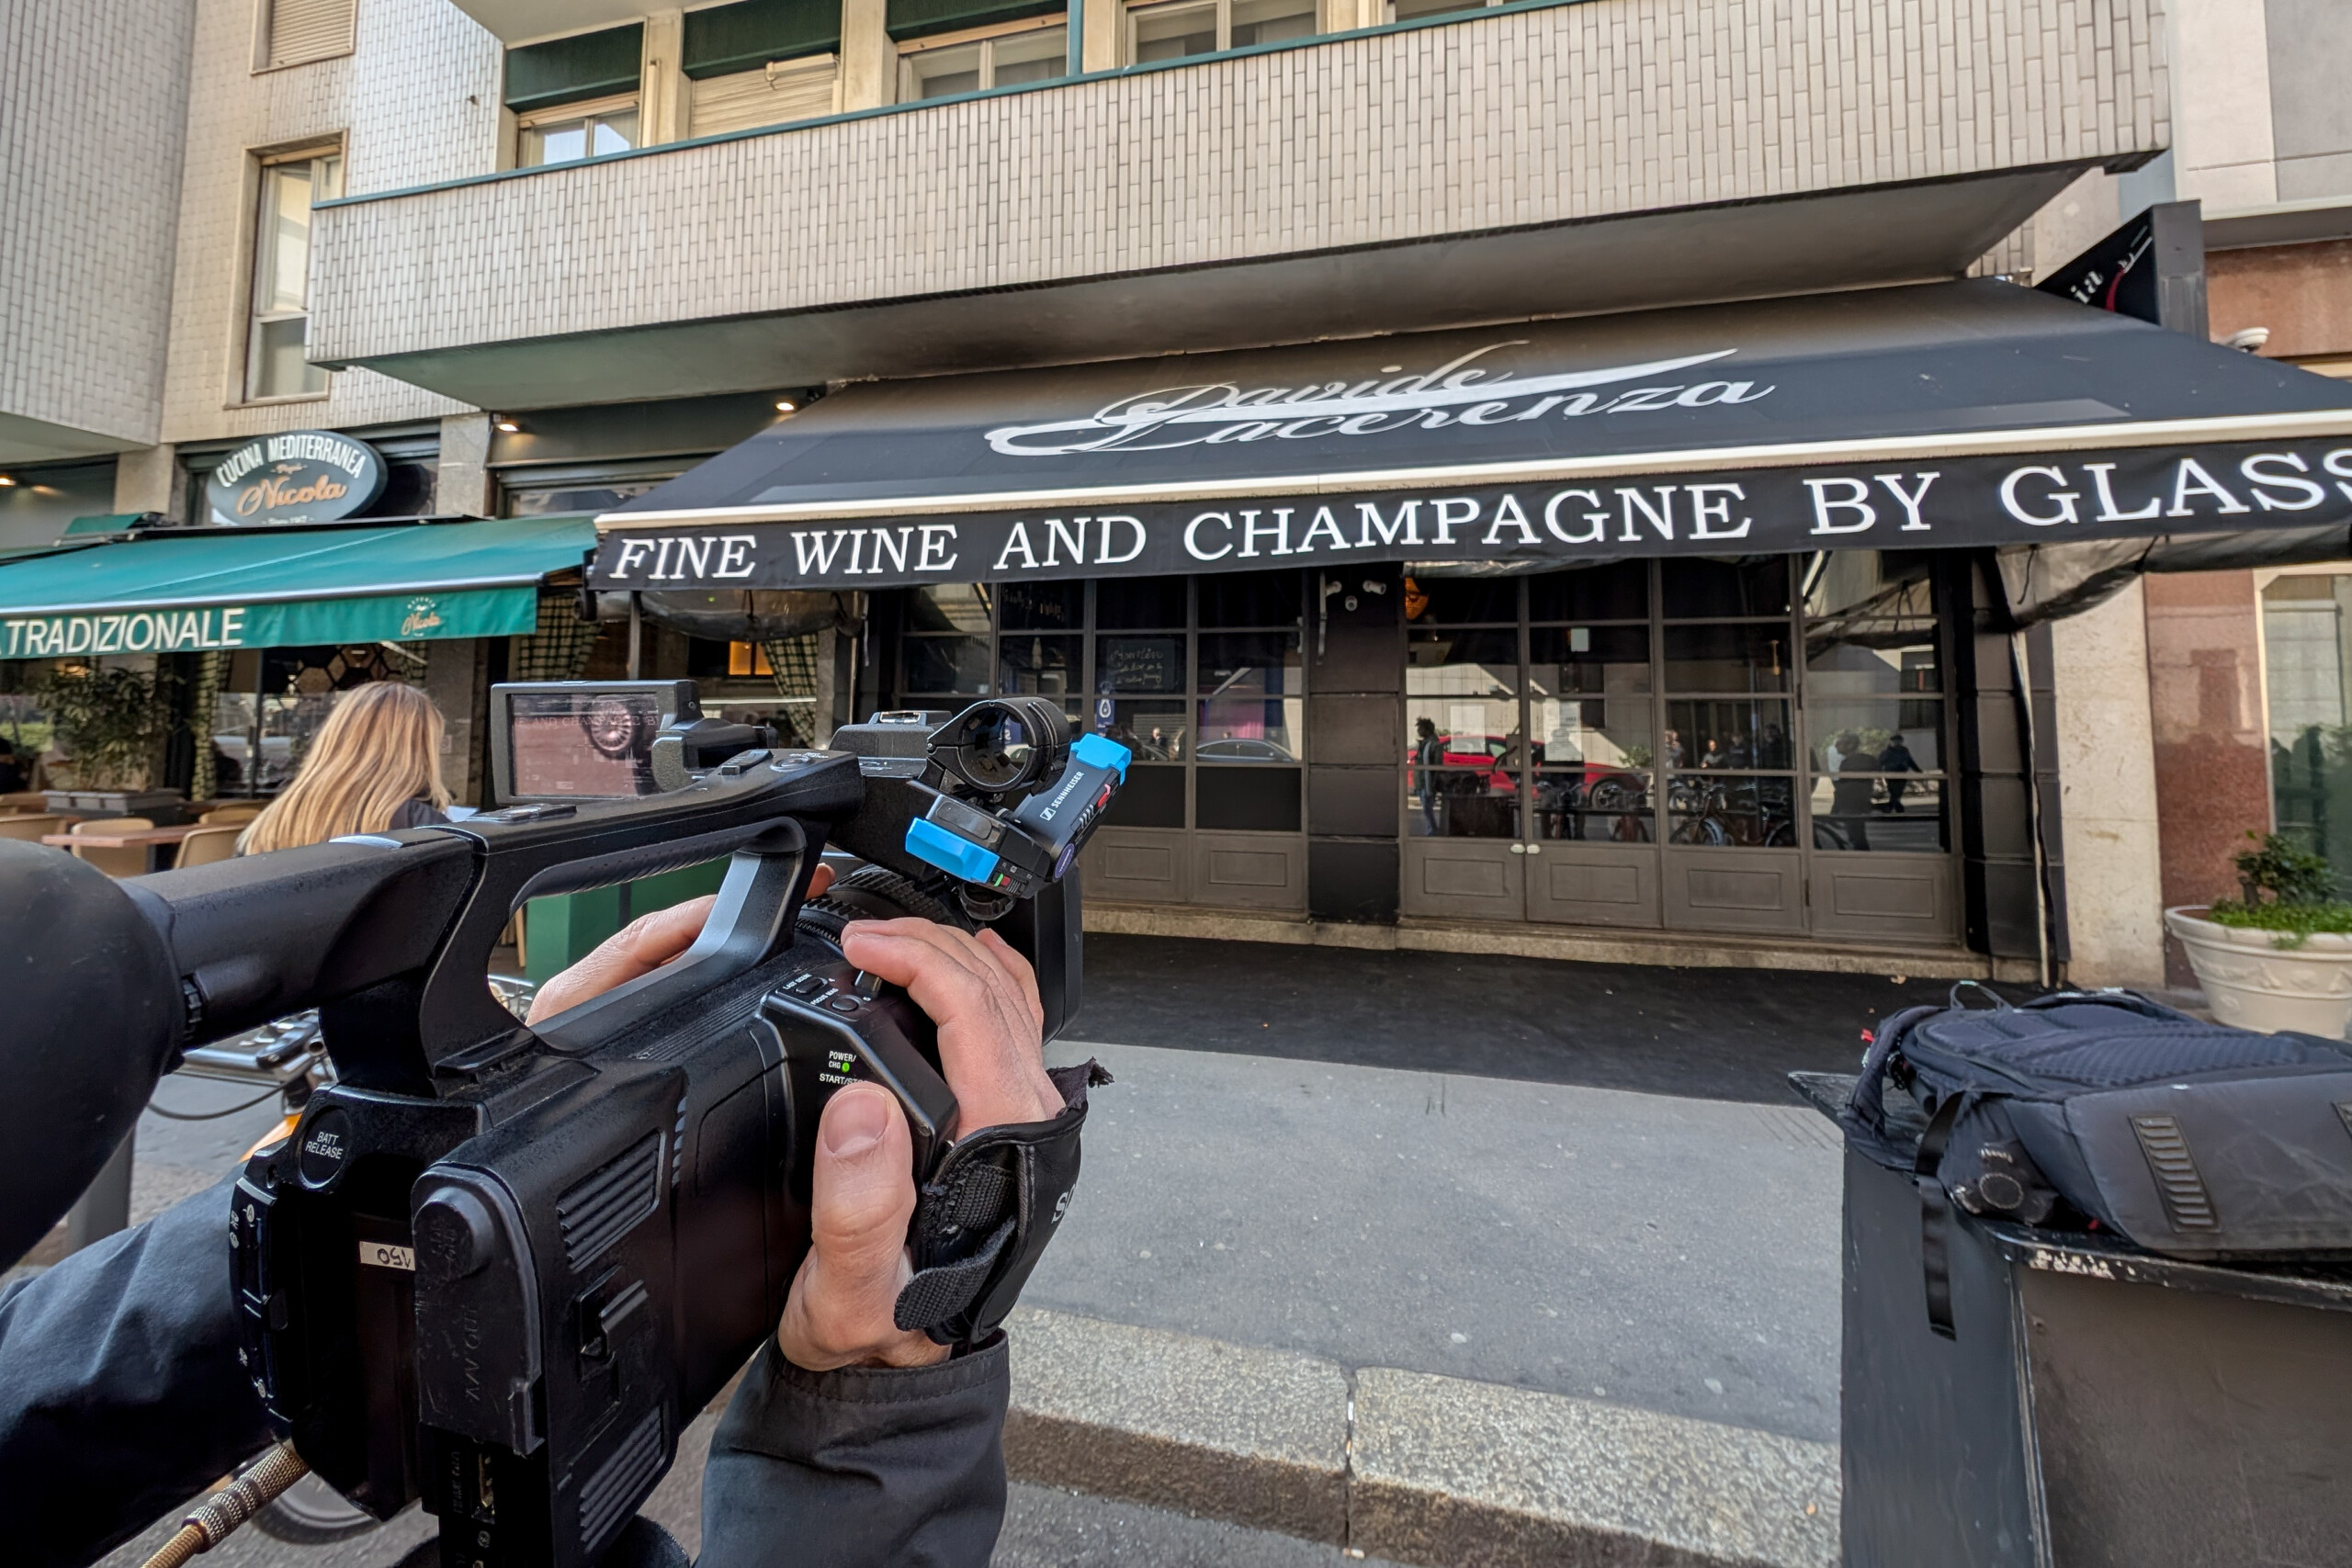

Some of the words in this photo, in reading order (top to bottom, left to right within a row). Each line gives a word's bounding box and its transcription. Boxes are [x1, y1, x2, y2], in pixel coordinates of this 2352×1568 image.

[1095, 341, 1531, 426] Davide
[985, 378, 1775, 457] Lacerenza
[216, 443, 265, 488] CUCINA
[267, 434, 367, 479] MEDITERRANEA
[235, 474, 348, 516] Nicola
[609, 536, 756, 579] FINE
[791, 525, 957, 575] WINE
[993, 516, 1146, 570] AND
[1182, 482, 1751, 561] CHAMPAGNE
[1804, 472, 1939, 535] BY
[6, 608, 245, 655] TRADIZIONALE
[1051, 772, 1084, 808] SENNHEISER
[828, 1060, 841, 1069] CHG
[829, 1050, 857, 1063] POWER/
[305, 1141, 344, 1160] RELEASE
[316, 1131, 339, 1145] BATT
